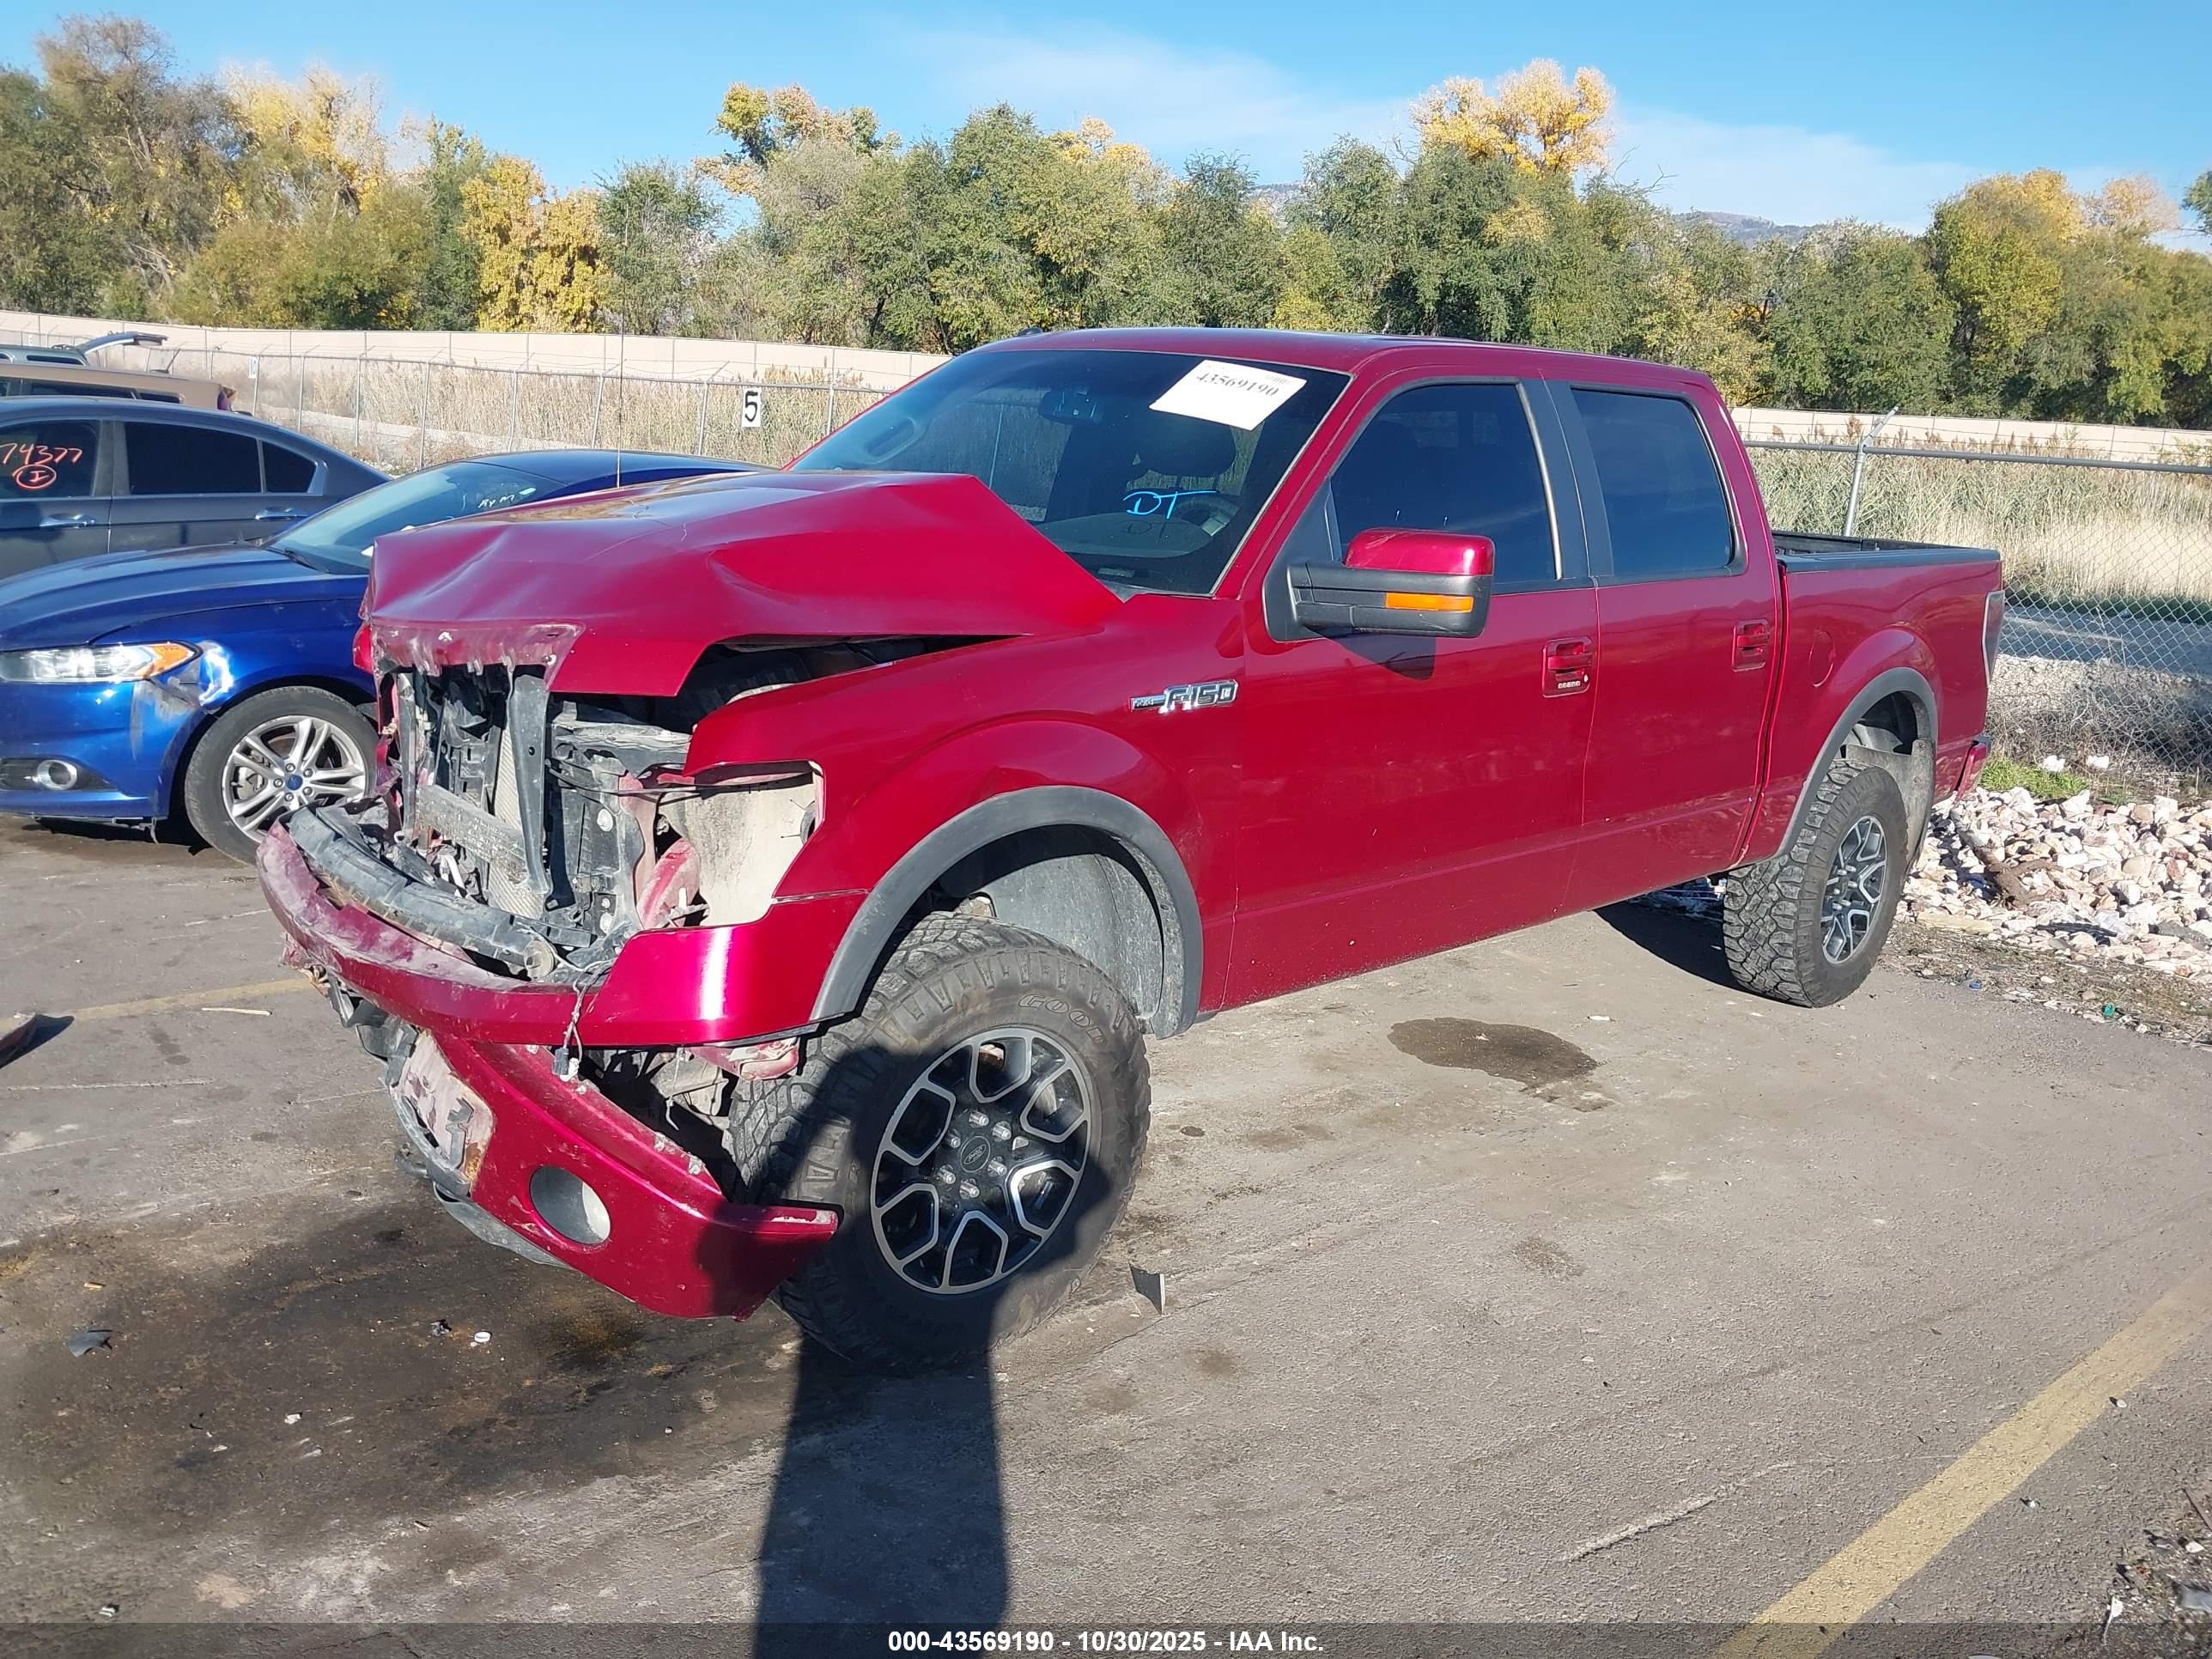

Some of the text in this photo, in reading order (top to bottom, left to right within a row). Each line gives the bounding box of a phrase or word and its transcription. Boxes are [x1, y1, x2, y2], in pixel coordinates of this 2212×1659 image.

[1196, 373, 1279, 396] 43569190
[744, 391, 758, 422] 5
[0, 442, 83, 465] 74377
[1121, 490, 1218, 520] DT
